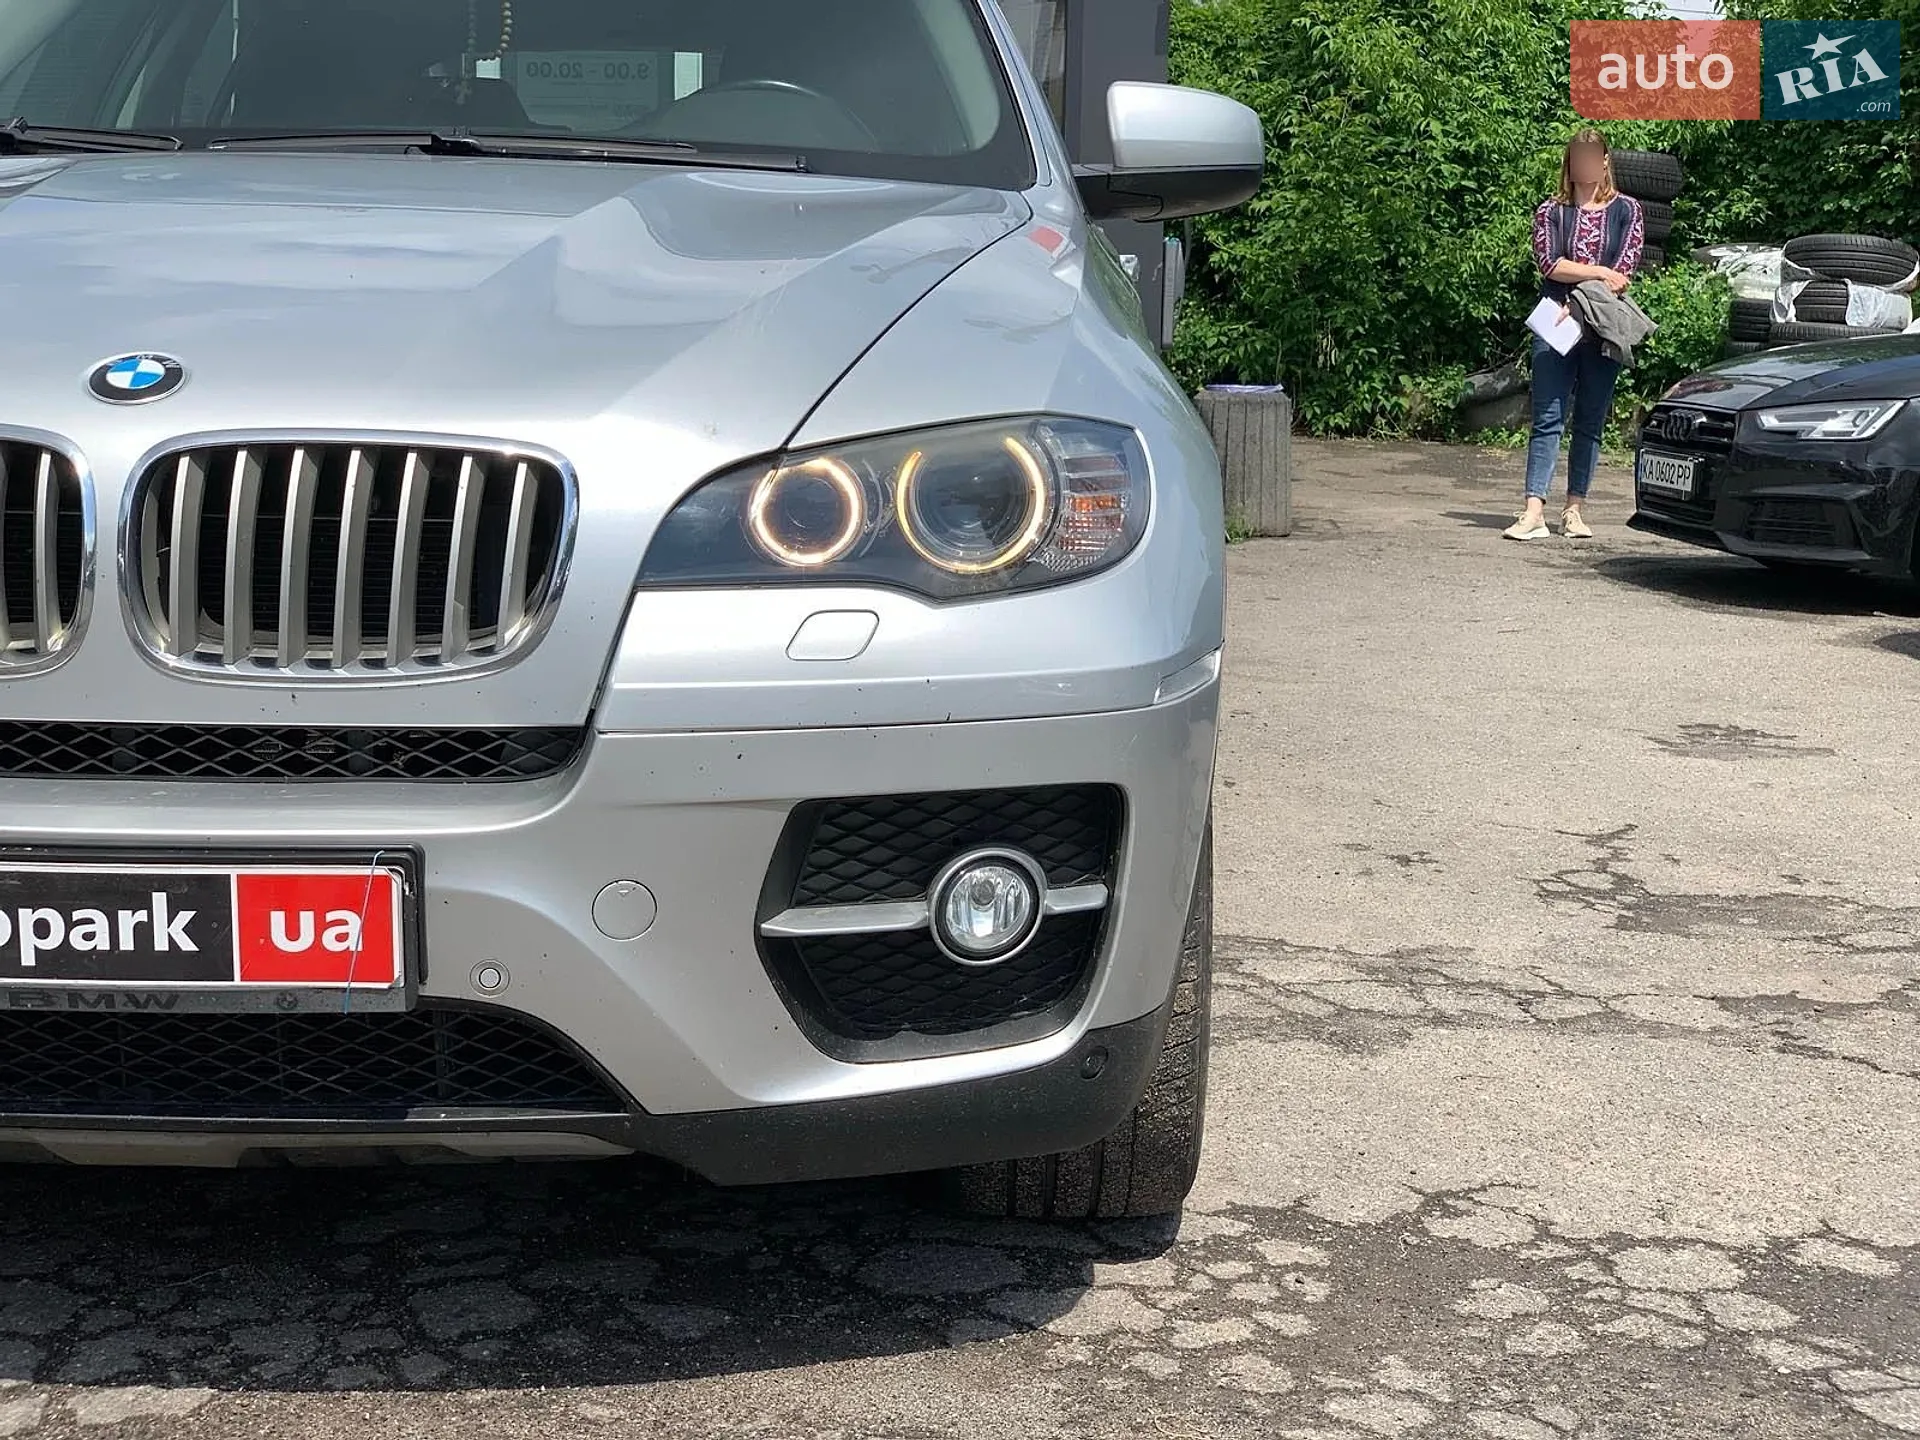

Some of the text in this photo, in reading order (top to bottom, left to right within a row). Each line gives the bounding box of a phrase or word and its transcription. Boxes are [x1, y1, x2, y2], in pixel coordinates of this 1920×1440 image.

[1656, 461, 1676, 484] 0602
[1677, 464, 1691, 487] PP
[0, 891, 363, 966] park ua
[8, 991, 180, 1009] BMW
